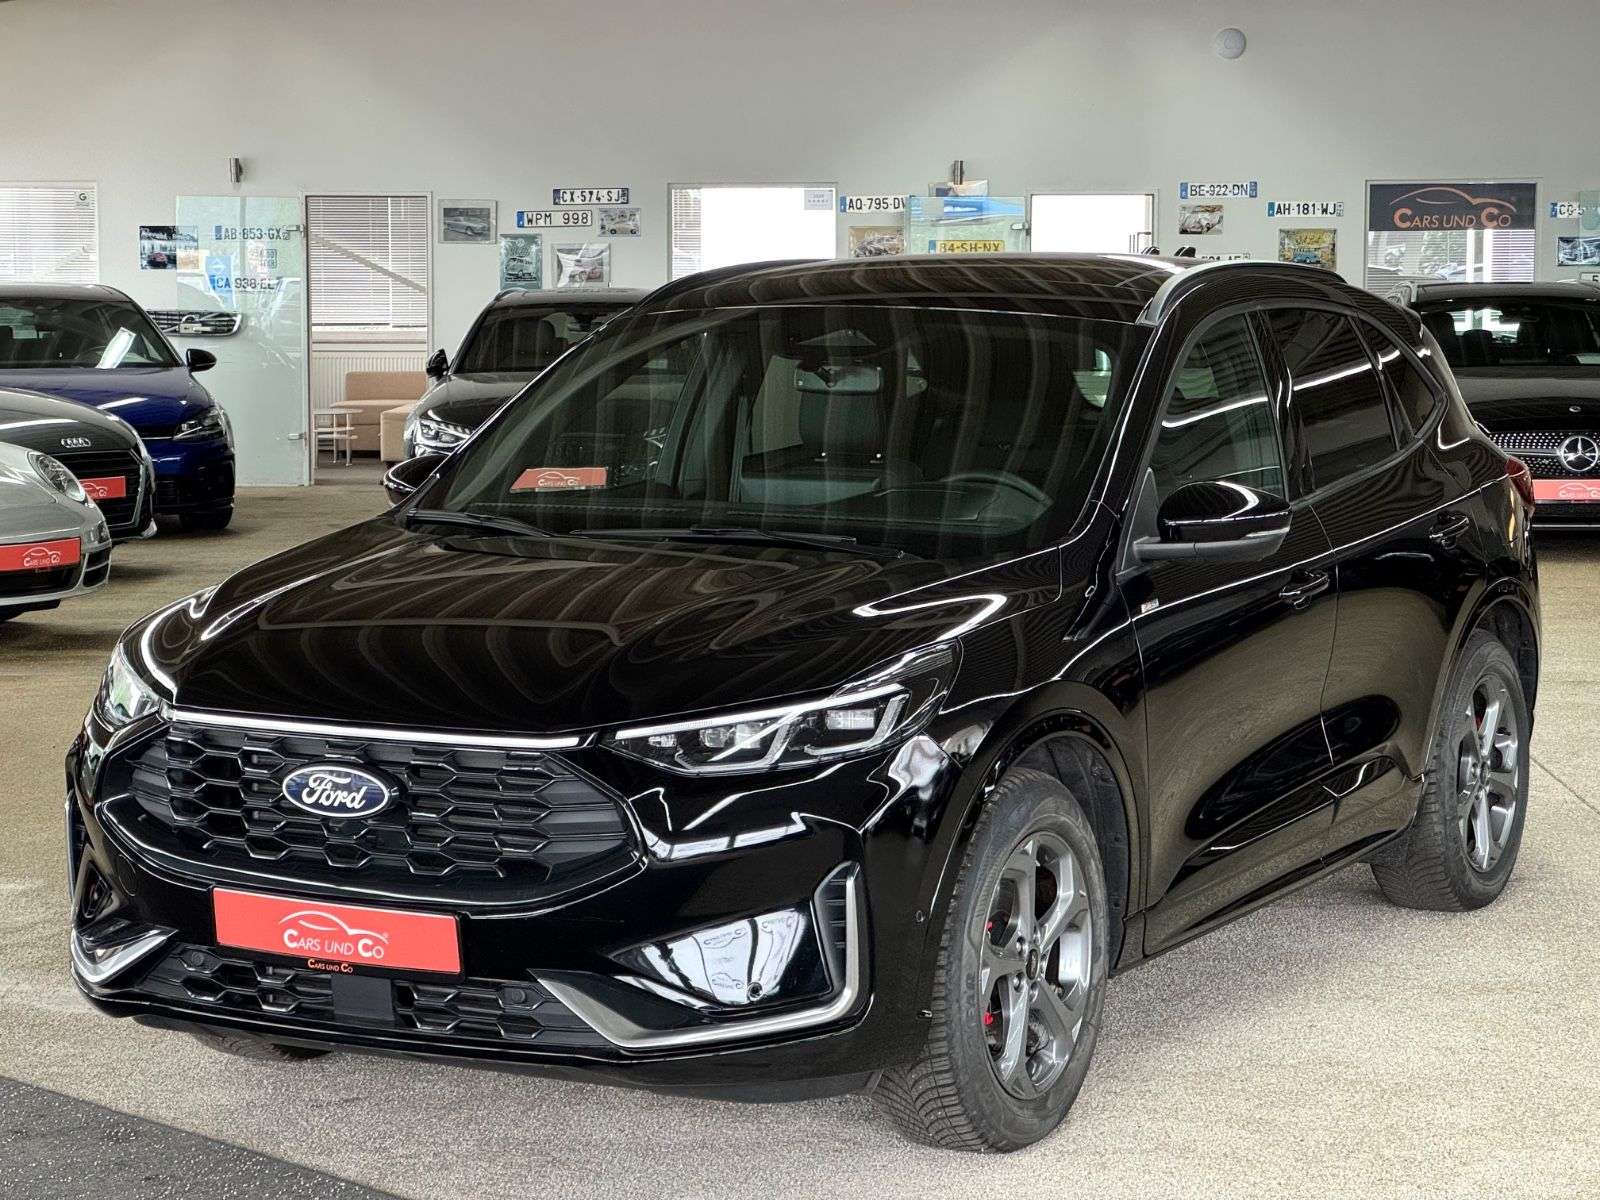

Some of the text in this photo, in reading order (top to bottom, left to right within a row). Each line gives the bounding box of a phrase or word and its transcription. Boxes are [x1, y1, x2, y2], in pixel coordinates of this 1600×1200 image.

[561, 190, 621, 203] CX-574-SJ
[1190, 184, 1249, 197] BE-922-DN
[1275, 203, 1337, 216] AH-181-WJ
[526, 212, 589, 226] WPM 998
[302, 773, 369, 810] Ford
